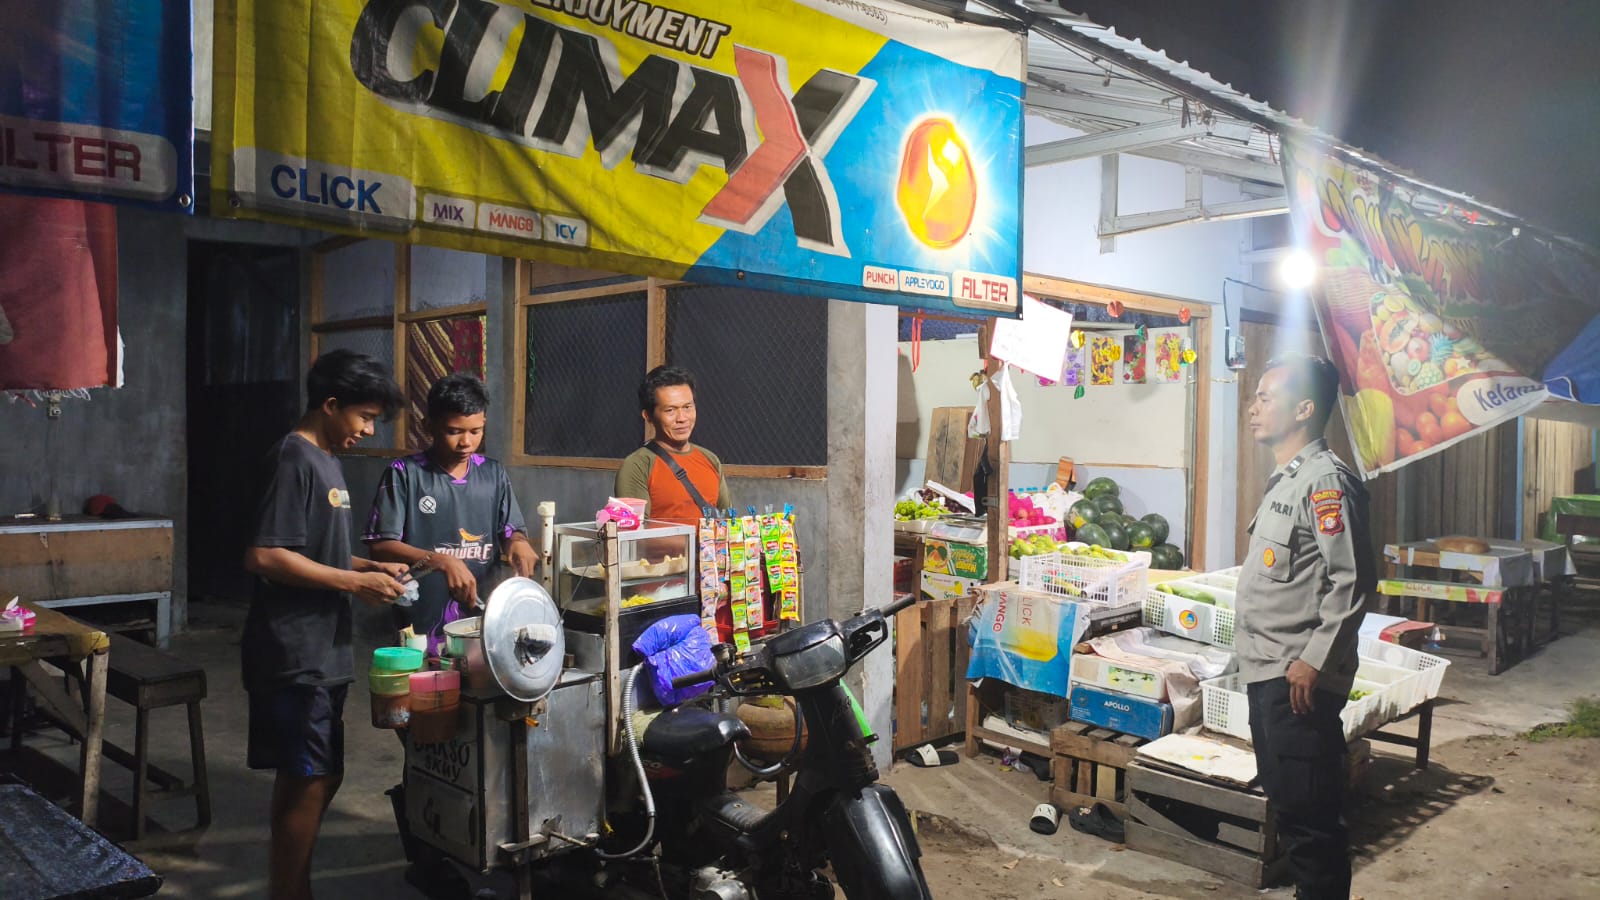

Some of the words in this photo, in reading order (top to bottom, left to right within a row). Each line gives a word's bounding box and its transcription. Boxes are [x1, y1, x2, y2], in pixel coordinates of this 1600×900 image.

[531, 0, 731, 59] JOYMENT
[349, 0, 872, 255] CLIMAX
[271, 164, 382, 214] CLICK
[433, 202, 464, 222] MIX
[489, 209, 534, 232] MANGO
[555, 223, 578, 240] ICY
[866, 270, 895, 285] PUNCH
[962, 277, 1008, 303] FILTER
[1269, 500, 1294, 517] POLRI
[1103, 700, 1130, 712] APOLLO
